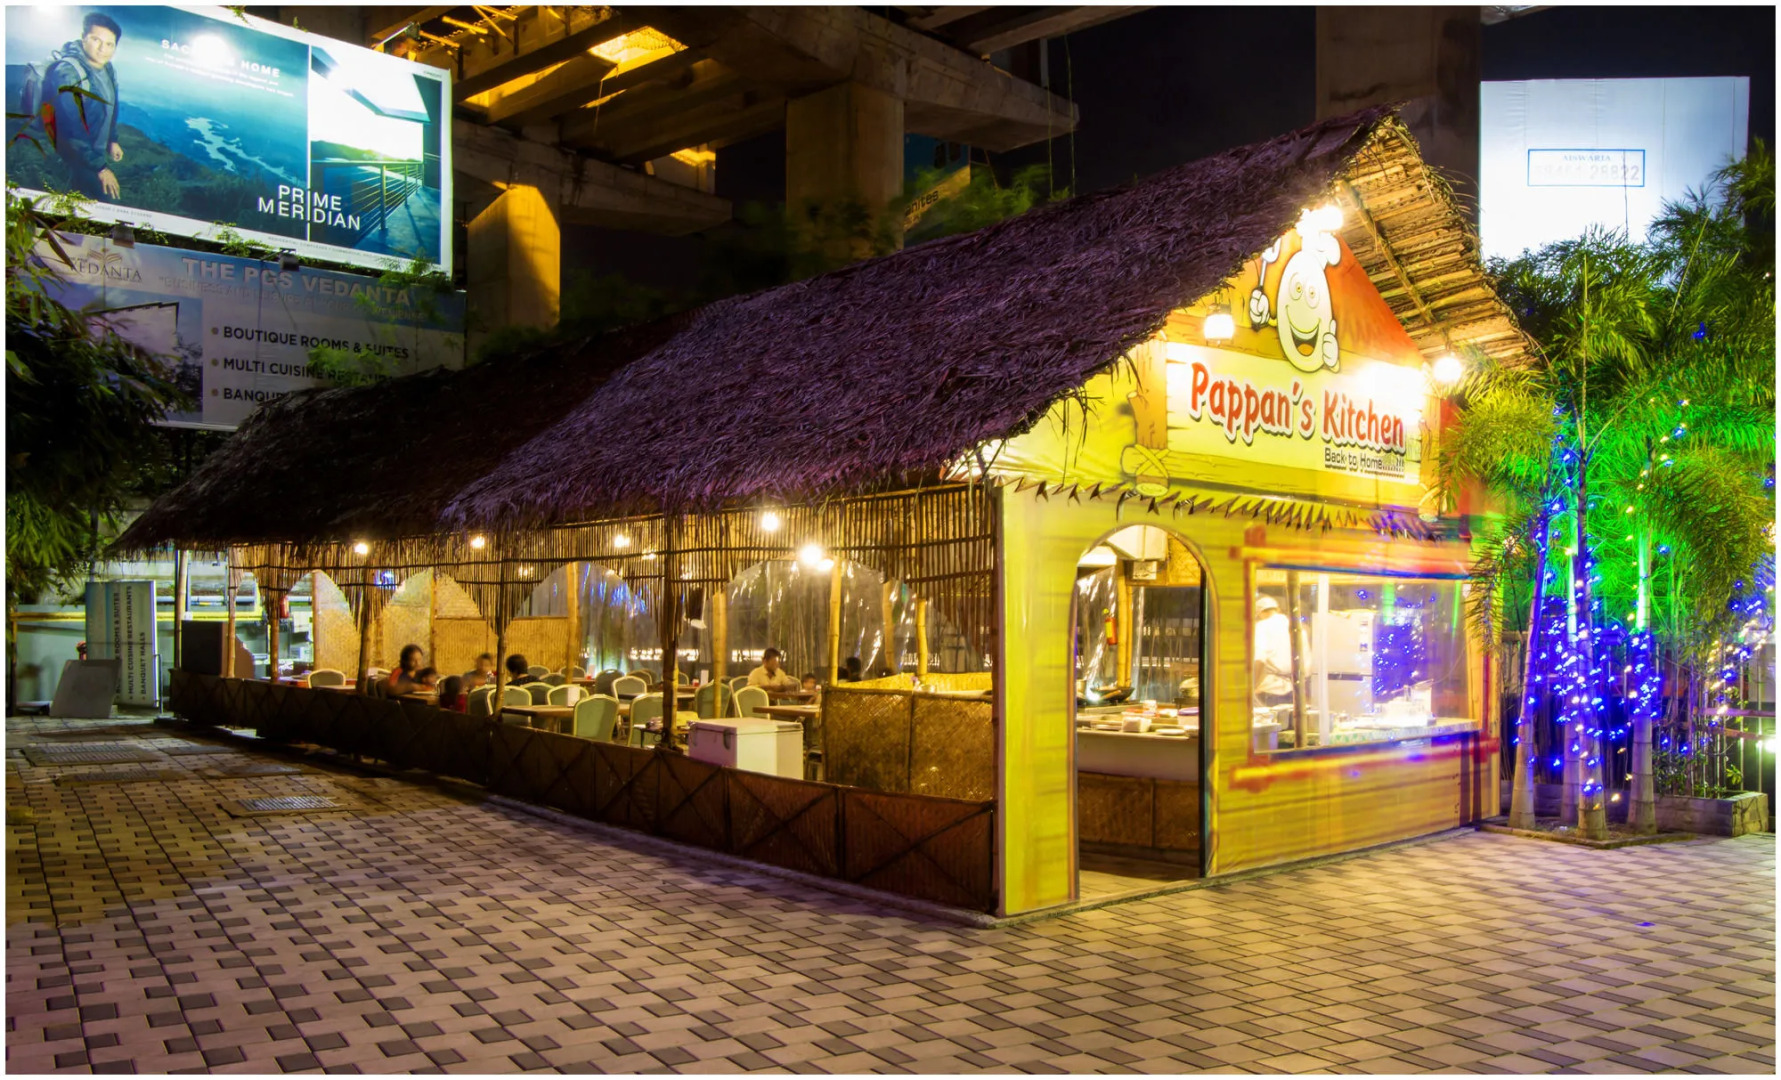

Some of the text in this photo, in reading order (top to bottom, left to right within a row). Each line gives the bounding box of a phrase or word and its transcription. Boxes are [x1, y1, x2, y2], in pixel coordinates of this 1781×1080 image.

[241, 60, 280, 78] HOME
[278, 184, 342, 212] PRIME
[258, 197, 361, 231] MERIDIAN
[182, 257, 236, 281] THE
[244, 266, 293, 289] PGS
[301, 274, 411, 307] VEDANTA
[223, 326, 298, 347] BOUTIQUE
[301, 337, 350, 352] ROOMS
[353, 341, 363, 353] &
[223, 357, 266, 374] MULTI
[269, 362, 324, 380] CUISINE
[1191, 362, 1406, 450] Pappan's Kitchen
[1324, 447, 1347, 465] Back
[1348, 452, 1358, 466] to
